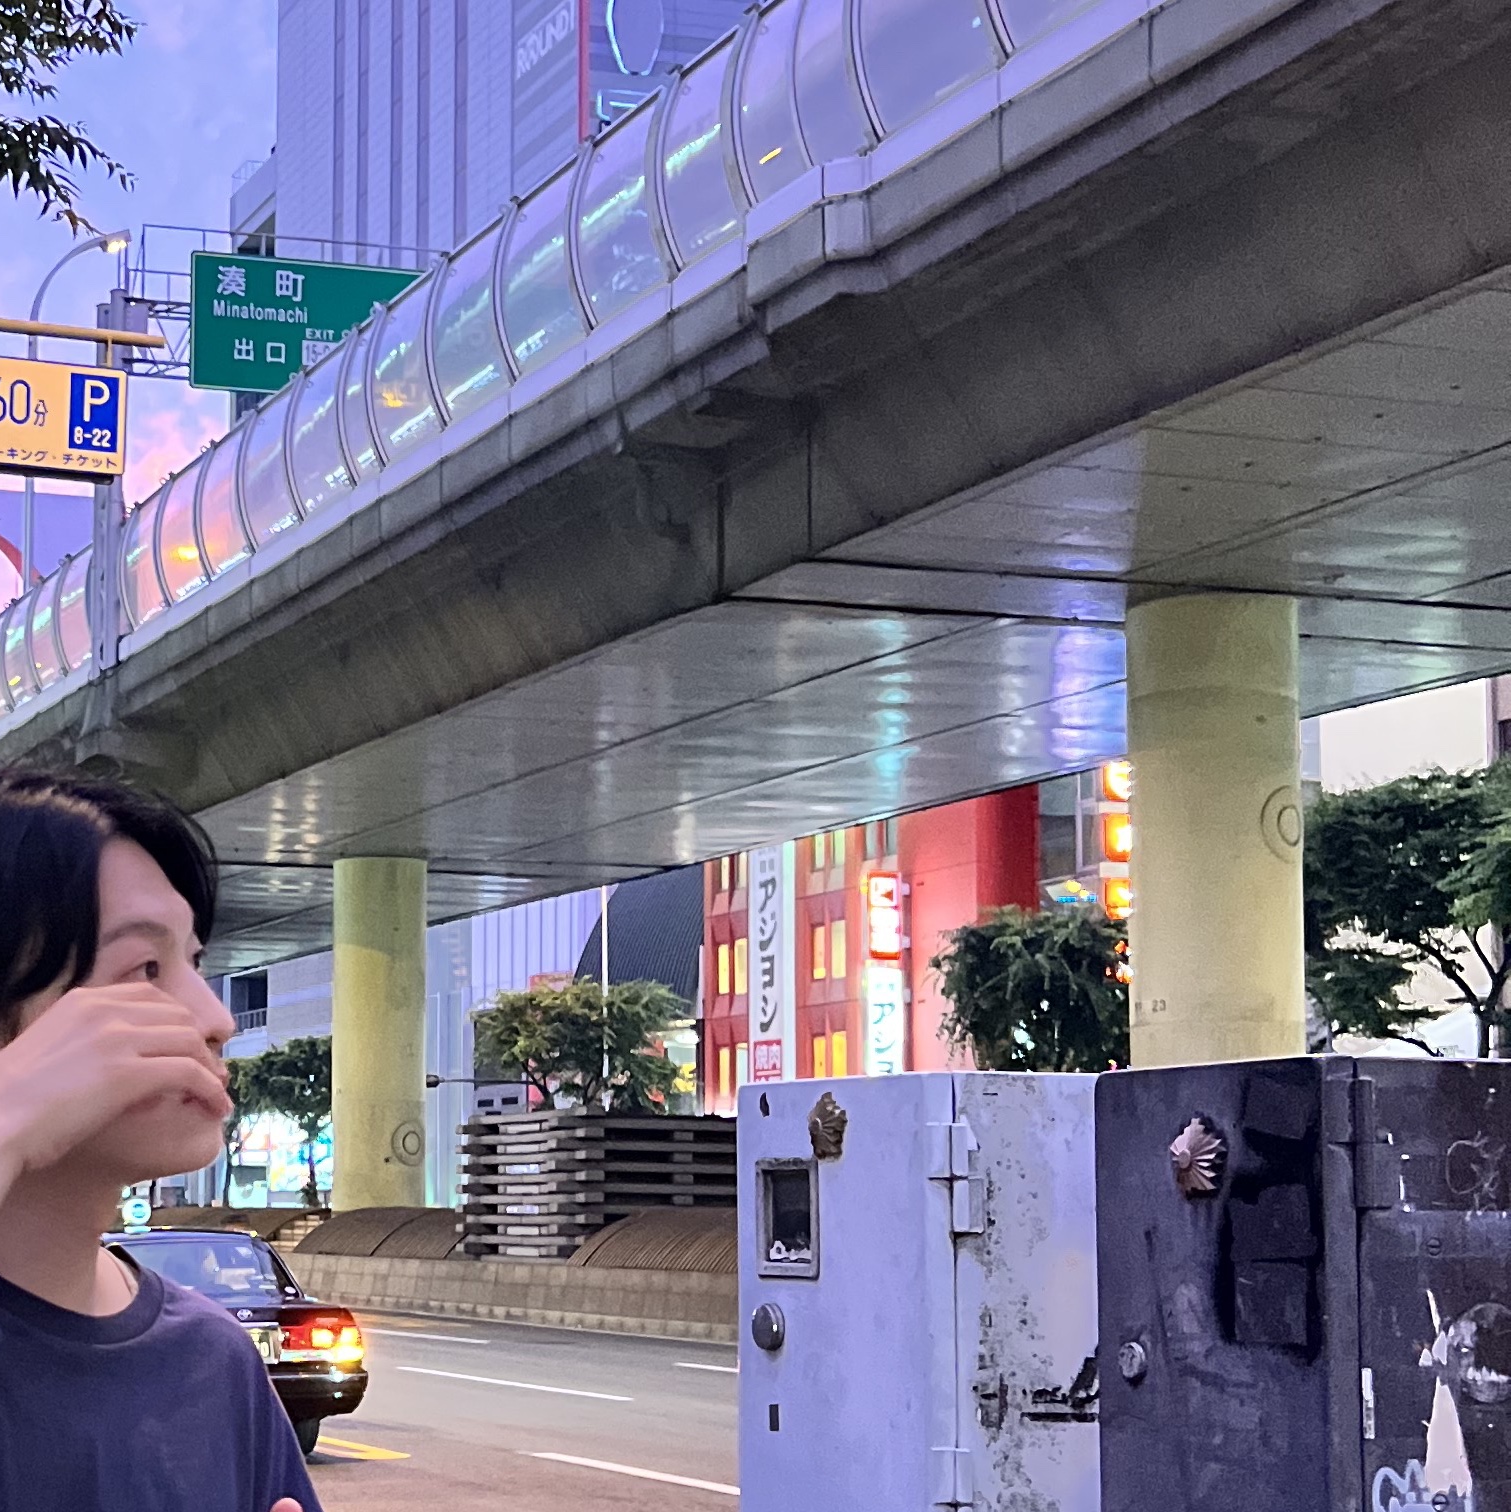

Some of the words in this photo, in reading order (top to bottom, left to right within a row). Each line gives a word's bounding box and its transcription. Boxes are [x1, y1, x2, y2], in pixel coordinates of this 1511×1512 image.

[216, 265, 305, 301] 湊町
[213, 299, 308, 323] Minatomachi
[305, 328, 335, 341] EXIT
[233, 337, 286, 364] 出口
[83, 379, 110, 422] P
[74, 426, 111, 448] 8-22
